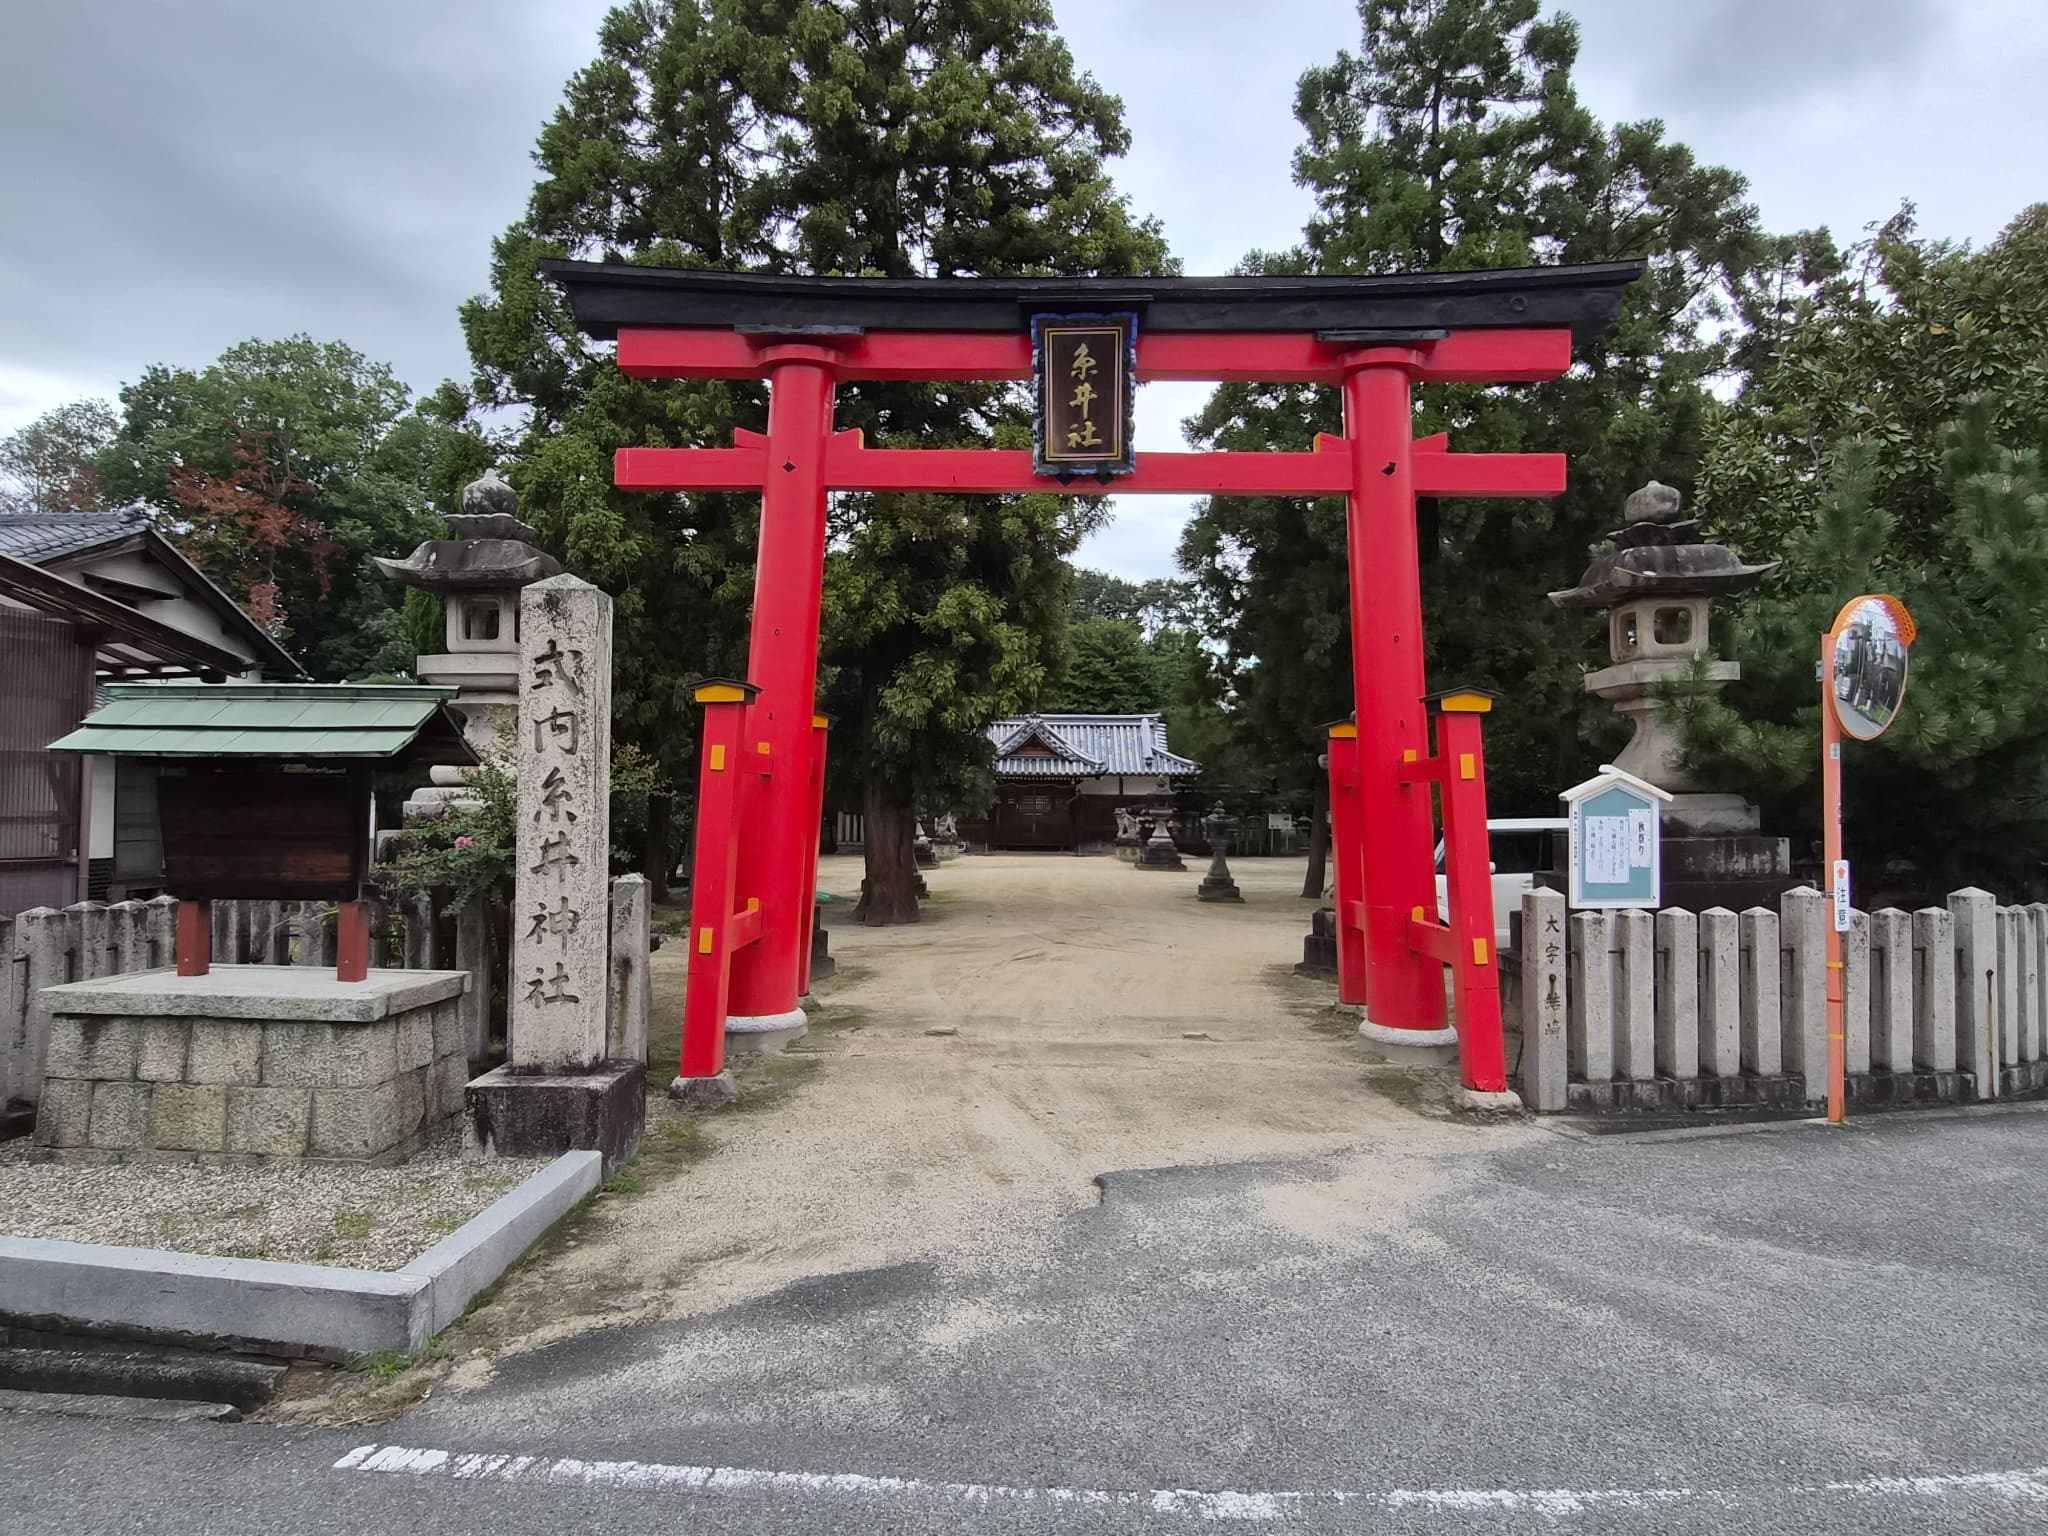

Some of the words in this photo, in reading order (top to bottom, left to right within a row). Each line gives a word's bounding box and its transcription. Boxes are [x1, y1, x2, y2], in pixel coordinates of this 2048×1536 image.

[522, 637, 585, 1009] 式内糸井神社
[1836, 887, 1847, 926] 注意
